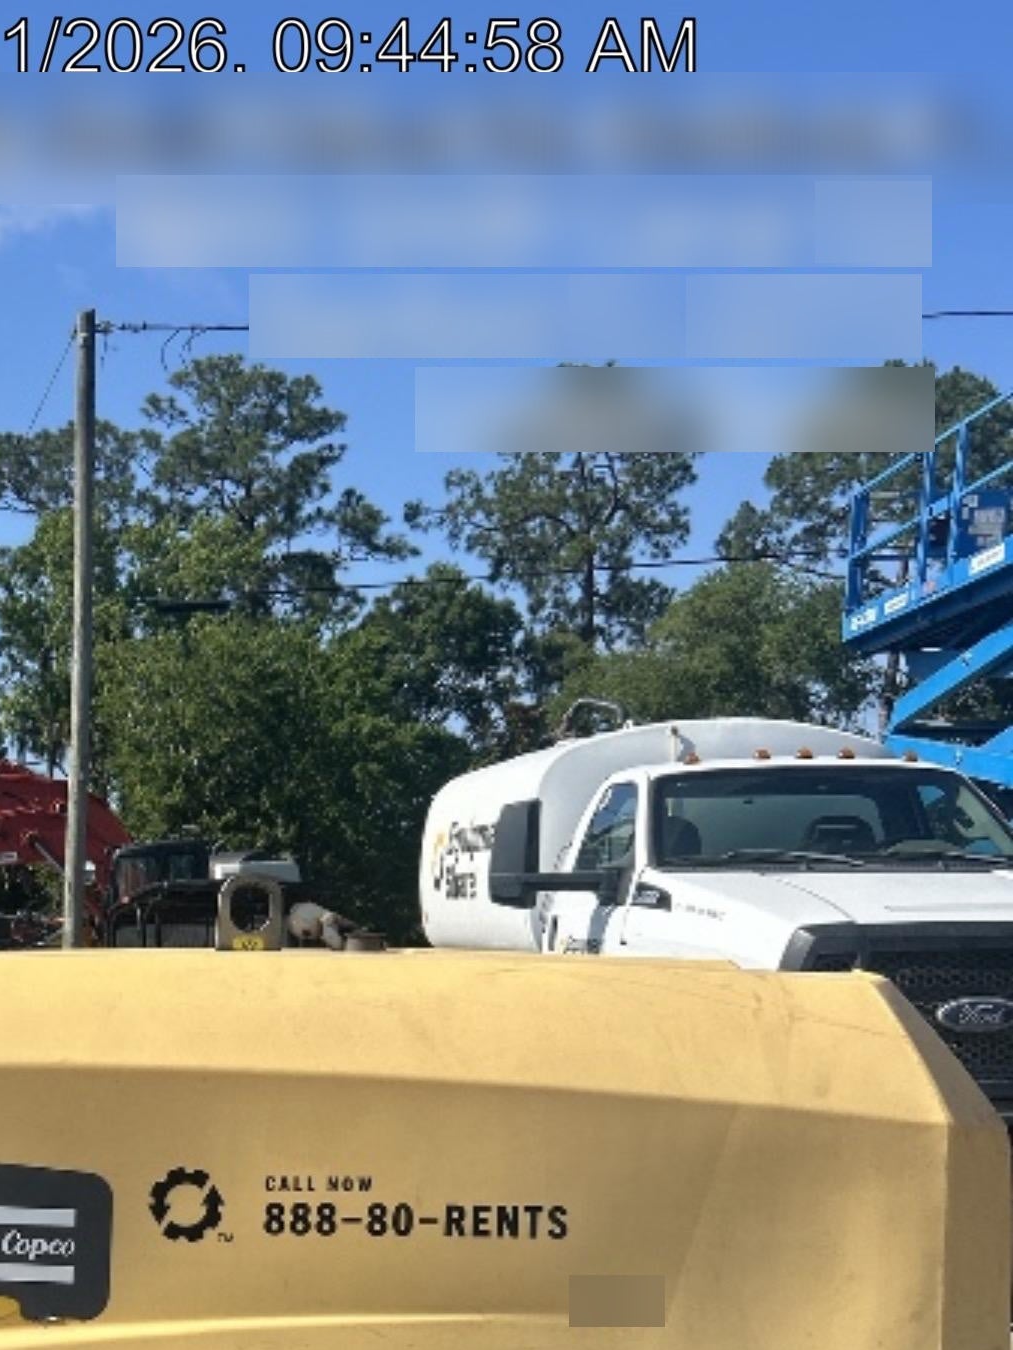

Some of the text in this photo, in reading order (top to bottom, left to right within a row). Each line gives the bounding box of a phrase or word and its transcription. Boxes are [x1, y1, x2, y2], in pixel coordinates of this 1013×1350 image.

[265, 1176, 373, 1192] CALL NOW
[263, 1202, 568, 1239] 888-80-RENTS
[1, 1229, 75, 1261] Copco
